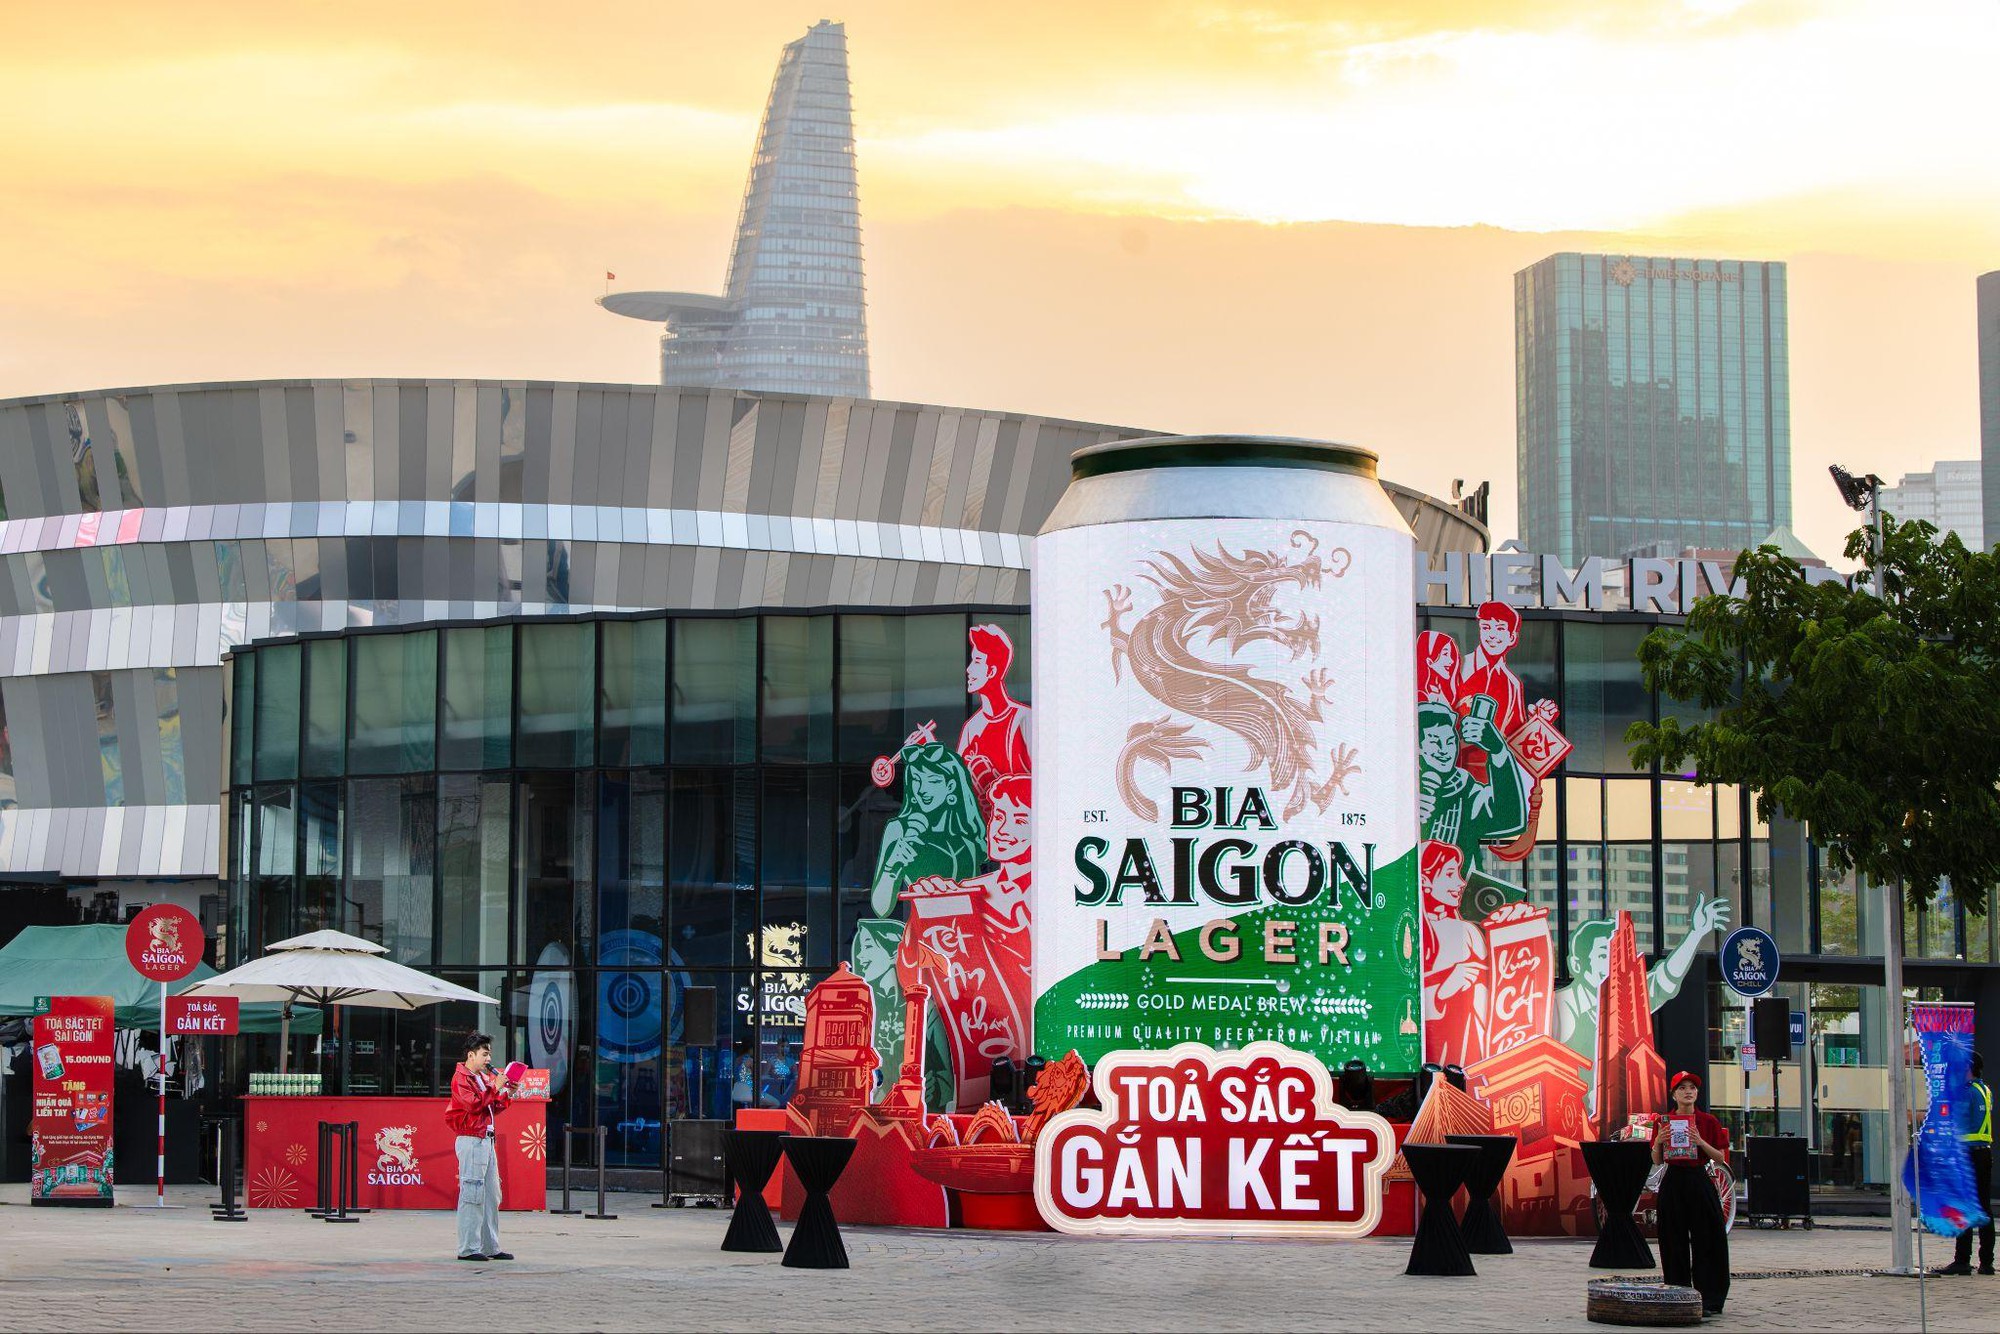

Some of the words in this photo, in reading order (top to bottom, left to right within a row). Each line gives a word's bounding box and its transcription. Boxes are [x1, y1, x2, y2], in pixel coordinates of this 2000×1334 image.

[1684, 270, 1739, 283] SQUARE
[1170, 786, 1278, 830] BIA
[1083, 810, 1109, 823] EST.
[1341, 813, 1366, 826] 1875
[1074, 836, 1376, 909] SAIGON
[1096, 918, 1350, 966] LAGER
[141, 953, 184, 964] SAIGON
[1733, 971, 1767, 981] SAIGON
[764, 982, 788, 994] BIA
[187, 1001, 201, 1012] TOẢ
[203, 1001, 217, 1012] SẮC
[1137, 994, 1184, 1010] GOLD
[1191, 995, 1251, 1011] MEDAL
[1258, 996, 1306, 1012] BREW
[177, 1012, 200, 1030] GẮN
[203, 1013, 226, 1030] KẾT
[1067, 1024, 1122, 1039] PREMIUM
[1133, 1026, 1202, 1040] QUALITY
[1215, 1027, 1254, 1042] BEER
[1267, 1028, 1309, 1043] FROM
[1321, 1029, 1378, 1045] VIETNAM
[1120, 1068, 1207, 1122] TOẢ
[1221, 1067, 1306, 1123] SẮC
[386, 1165, 403, 1173] BIA
[1061, 1125, 1202, 1209] GẮN
[1228, 1130, 1367, 1211] KẾT
[367, 1173, 421, 1185] SAIGON
